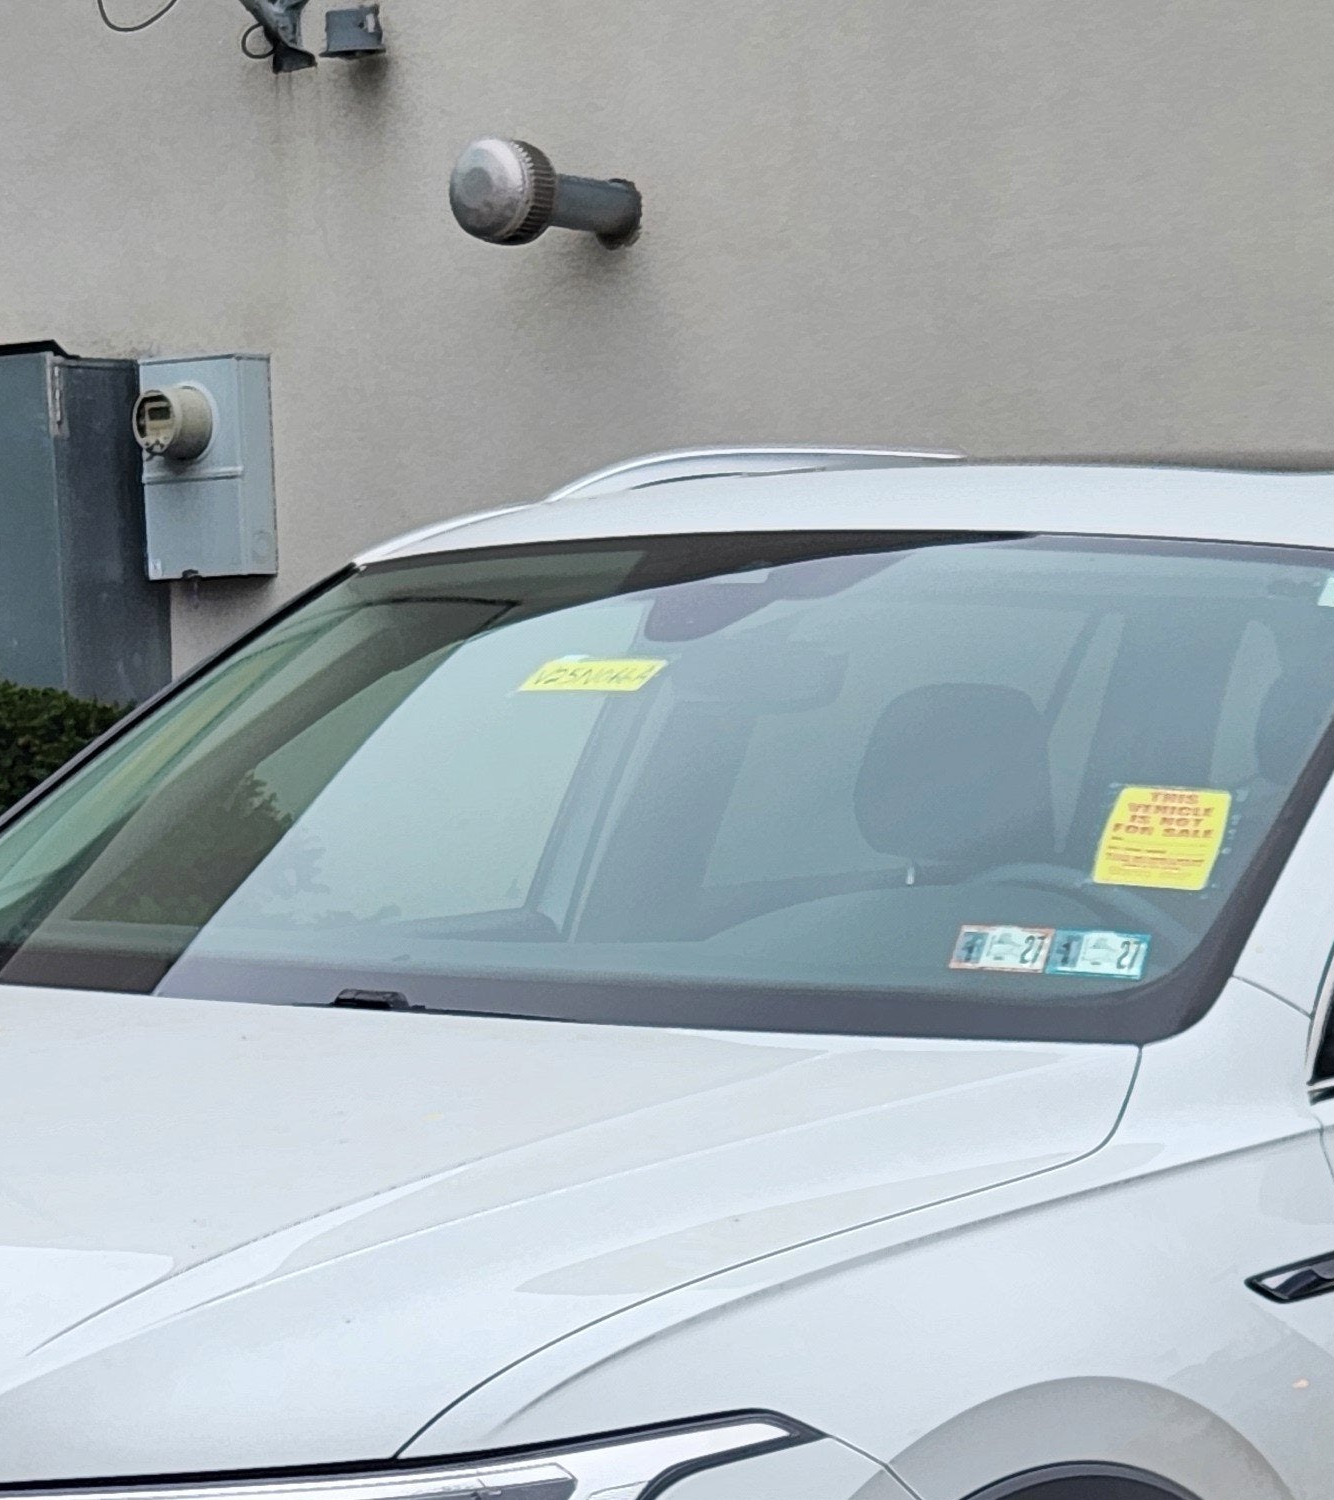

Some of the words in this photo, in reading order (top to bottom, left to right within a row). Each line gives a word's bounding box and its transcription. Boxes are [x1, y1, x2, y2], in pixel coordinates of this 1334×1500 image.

[1151, 792, 1199, 804] THIS
[1128, 803, 1214, 817] VEHICLE
[1130, 815, 1151, 824] IS
[1159, 817, 1204, 827] NOT
[1113, 823, 1154, 836] FOR
[1162, 828, 1214, 838] SALE
[1019, 935, 1047, 965] 27
[1116, 940, 1142, 970] 27
